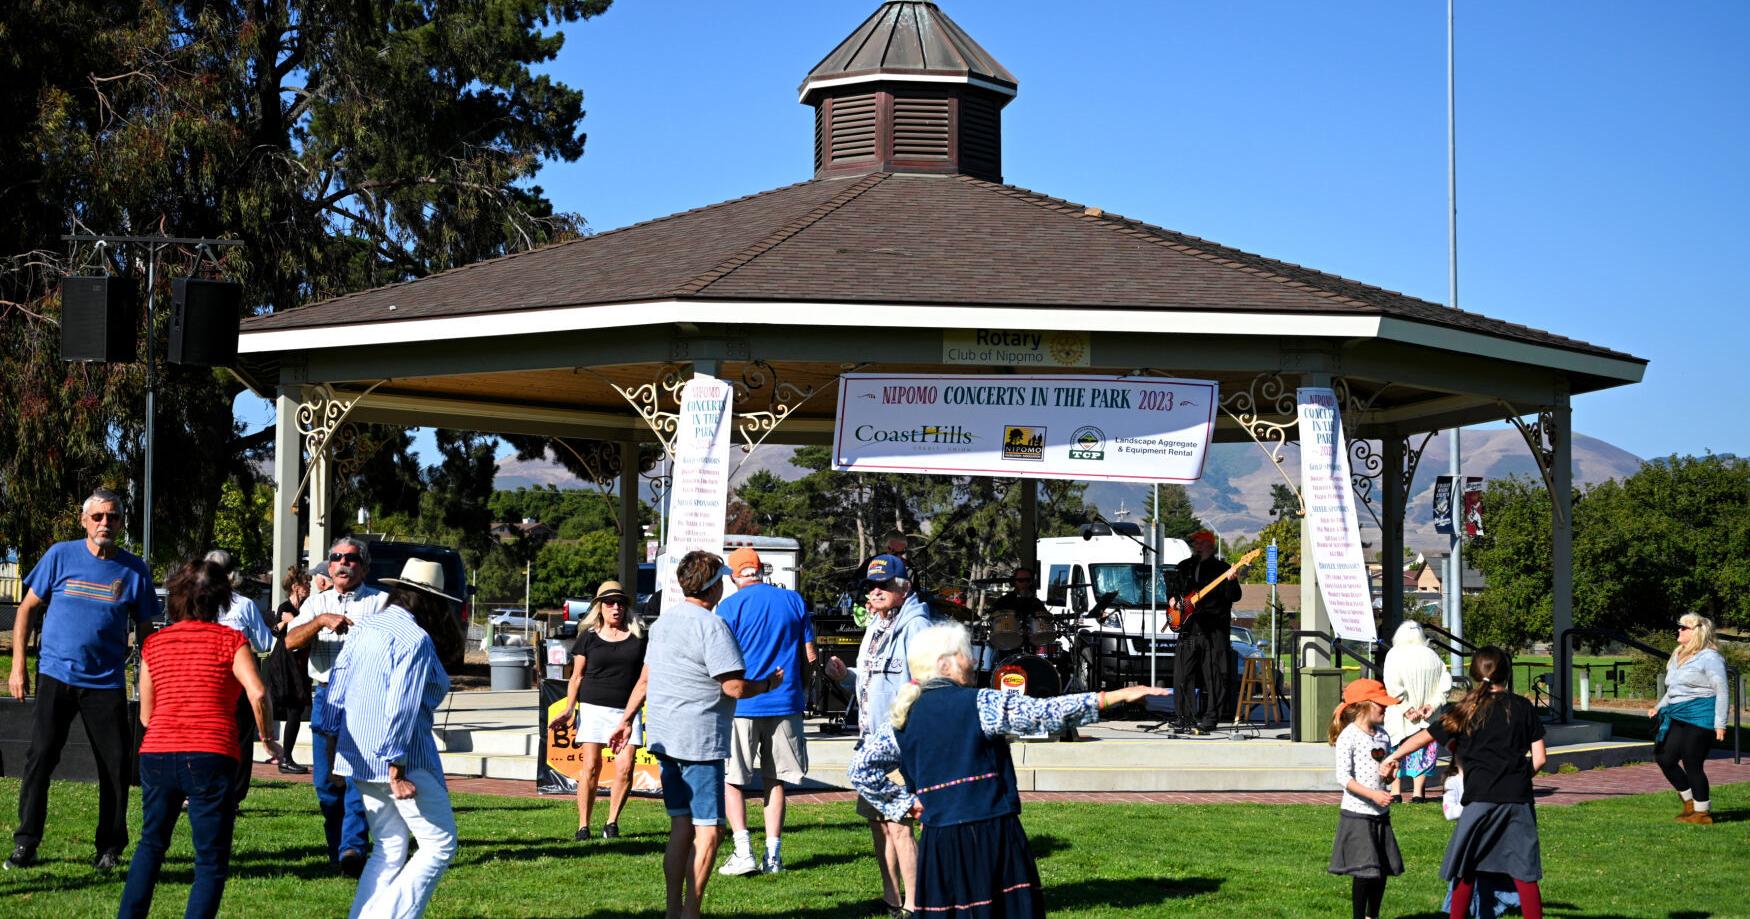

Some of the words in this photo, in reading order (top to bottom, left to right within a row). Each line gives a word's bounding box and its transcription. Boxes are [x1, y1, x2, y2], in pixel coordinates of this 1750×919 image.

[976, 328, 1042, 350] Rotary
[948, 348, 976, 361] Club
[980, 349, 993, 361] of
[997, 350, 1044, 363] Nipomo
[882, 385, 938, 405] NIPOMO
[943, 386, 1026, 406] CONCERTS
[1030, 386, 1049, 407] IN
[1054, 387, 1086, 408] THE
[1089, 388, 1132, 409] PARK
[1137, 390, 1174, 411] 2023
[1304, 408, 1336, 420] CONCER
[855, 424, 972, 445] CoastHills
[1115, 437, 1157, 446] Landscape
[1158, 439, 1198, 449] Aggregate
[1072, 450, 1101, 459] TCP
[1125, 446, 1166, 456] Equipment
[1168, 448, 1193, 457] Rental
